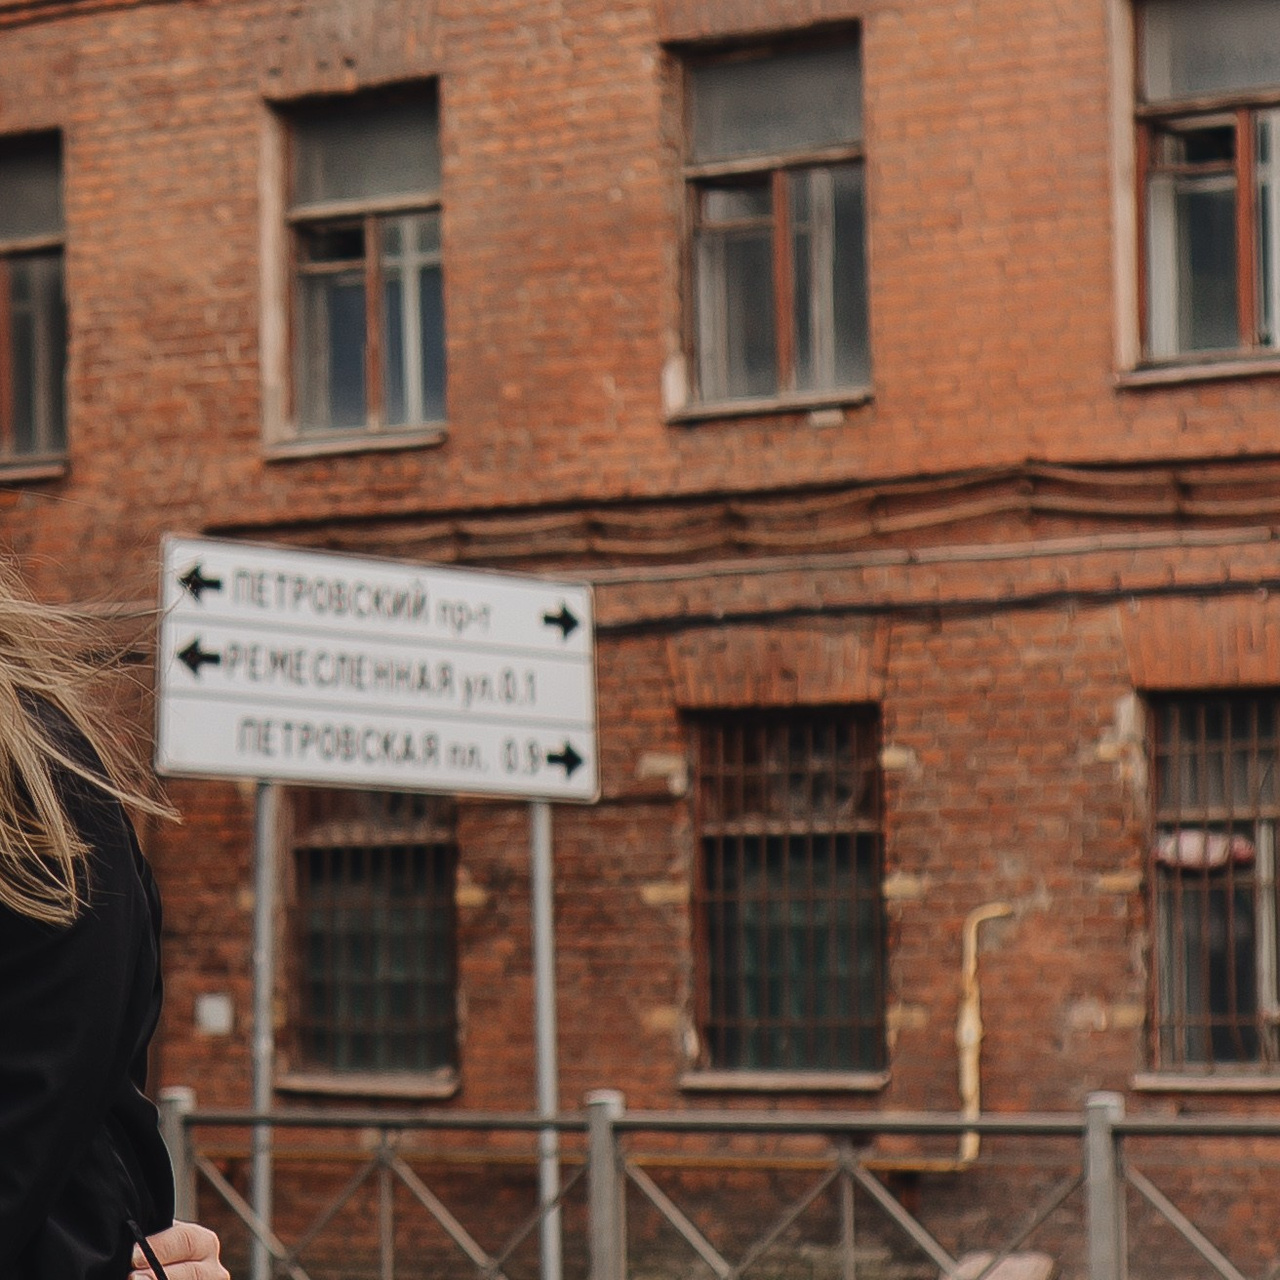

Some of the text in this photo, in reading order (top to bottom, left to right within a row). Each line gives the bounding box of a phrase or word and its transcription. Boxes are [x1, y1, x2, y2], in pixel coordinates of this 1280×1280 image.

[232, 569, 429, 618] ПЕТРОВСКИЙ
[225, 642, 453, 695] РЕМЕСЛЕННАЯ
[238, 717, 439, 765] ПЕТРОВСКАЯ
